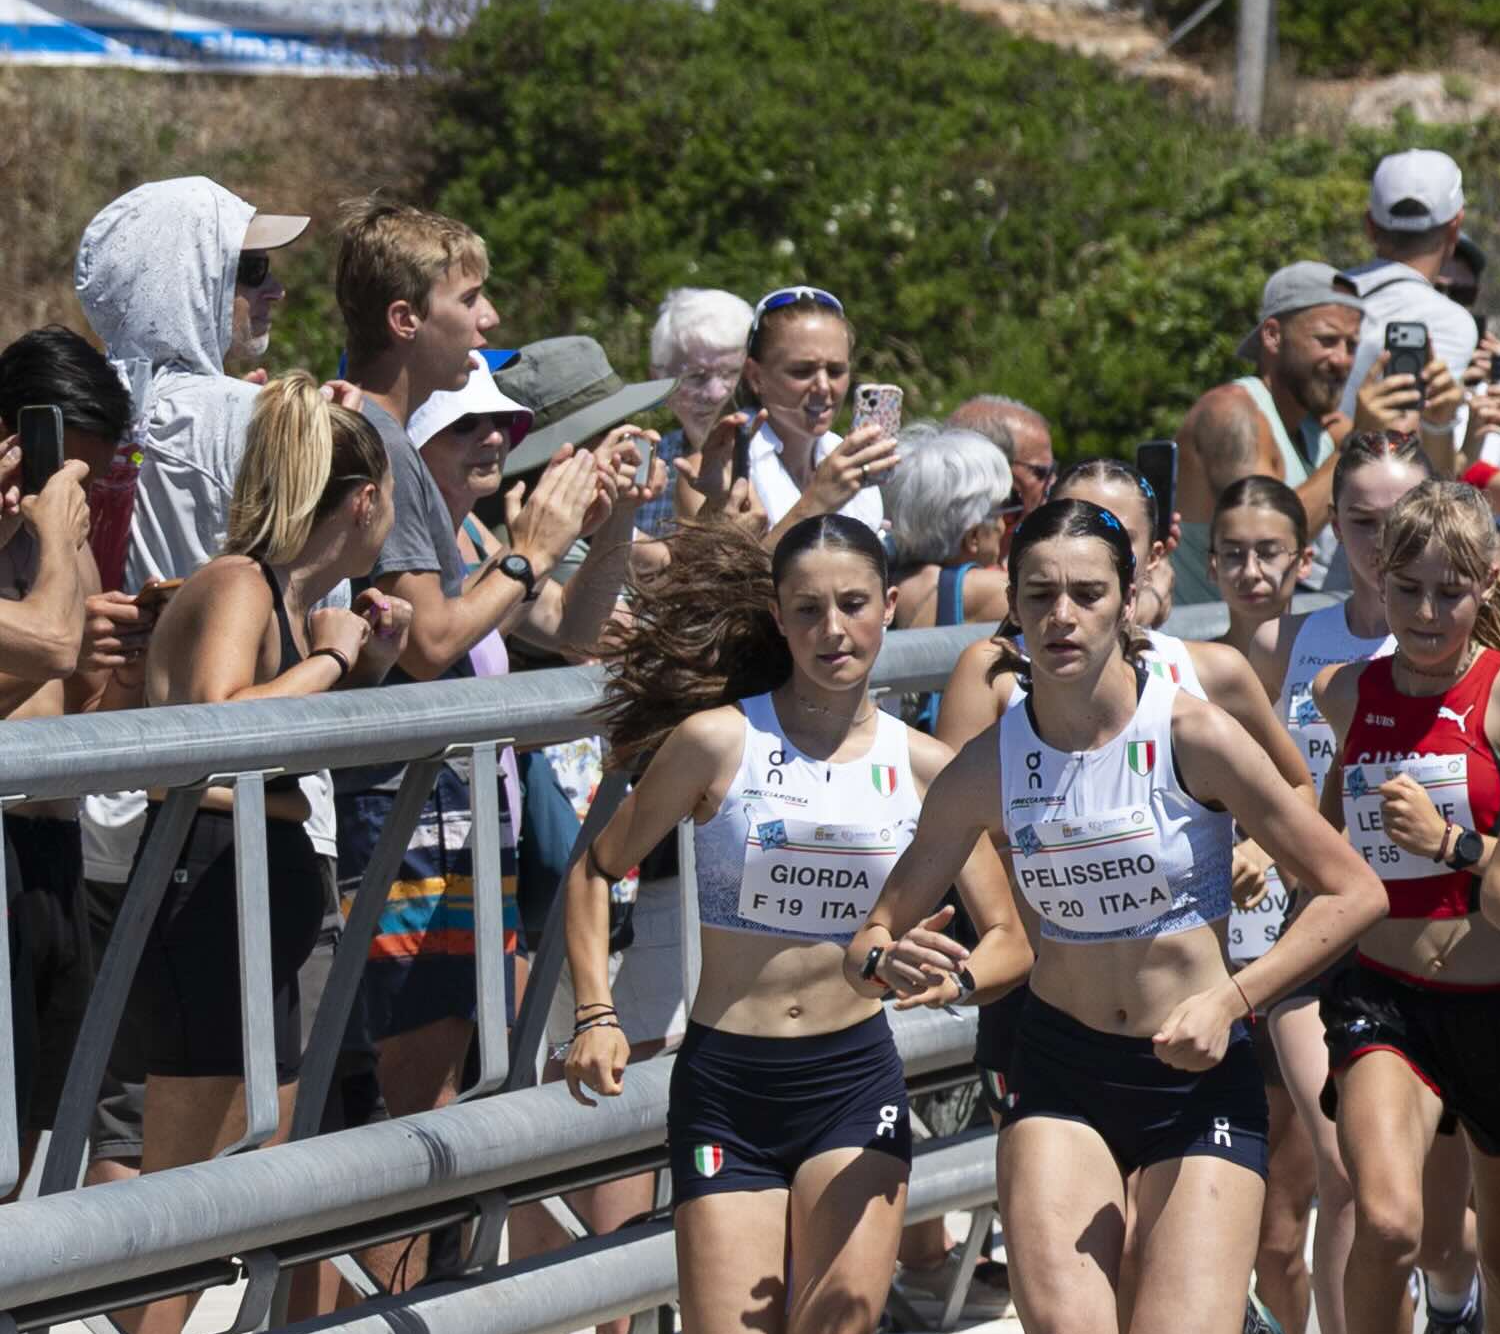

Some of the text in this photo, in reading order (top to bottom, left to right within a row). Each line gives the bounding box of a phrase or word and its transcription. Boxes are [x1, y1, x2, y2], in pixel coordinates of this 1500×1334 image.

[1363, 844, 1400, 864] F 55
[770, 864, 869, 889] GIORDA
[1021, 854, 1156, 889] PELISSERO
[753, 893, 768, 909] F
[776, 898, 803, 916] 19
[1039, 885, 1167, 917] F 20 ITA-A
